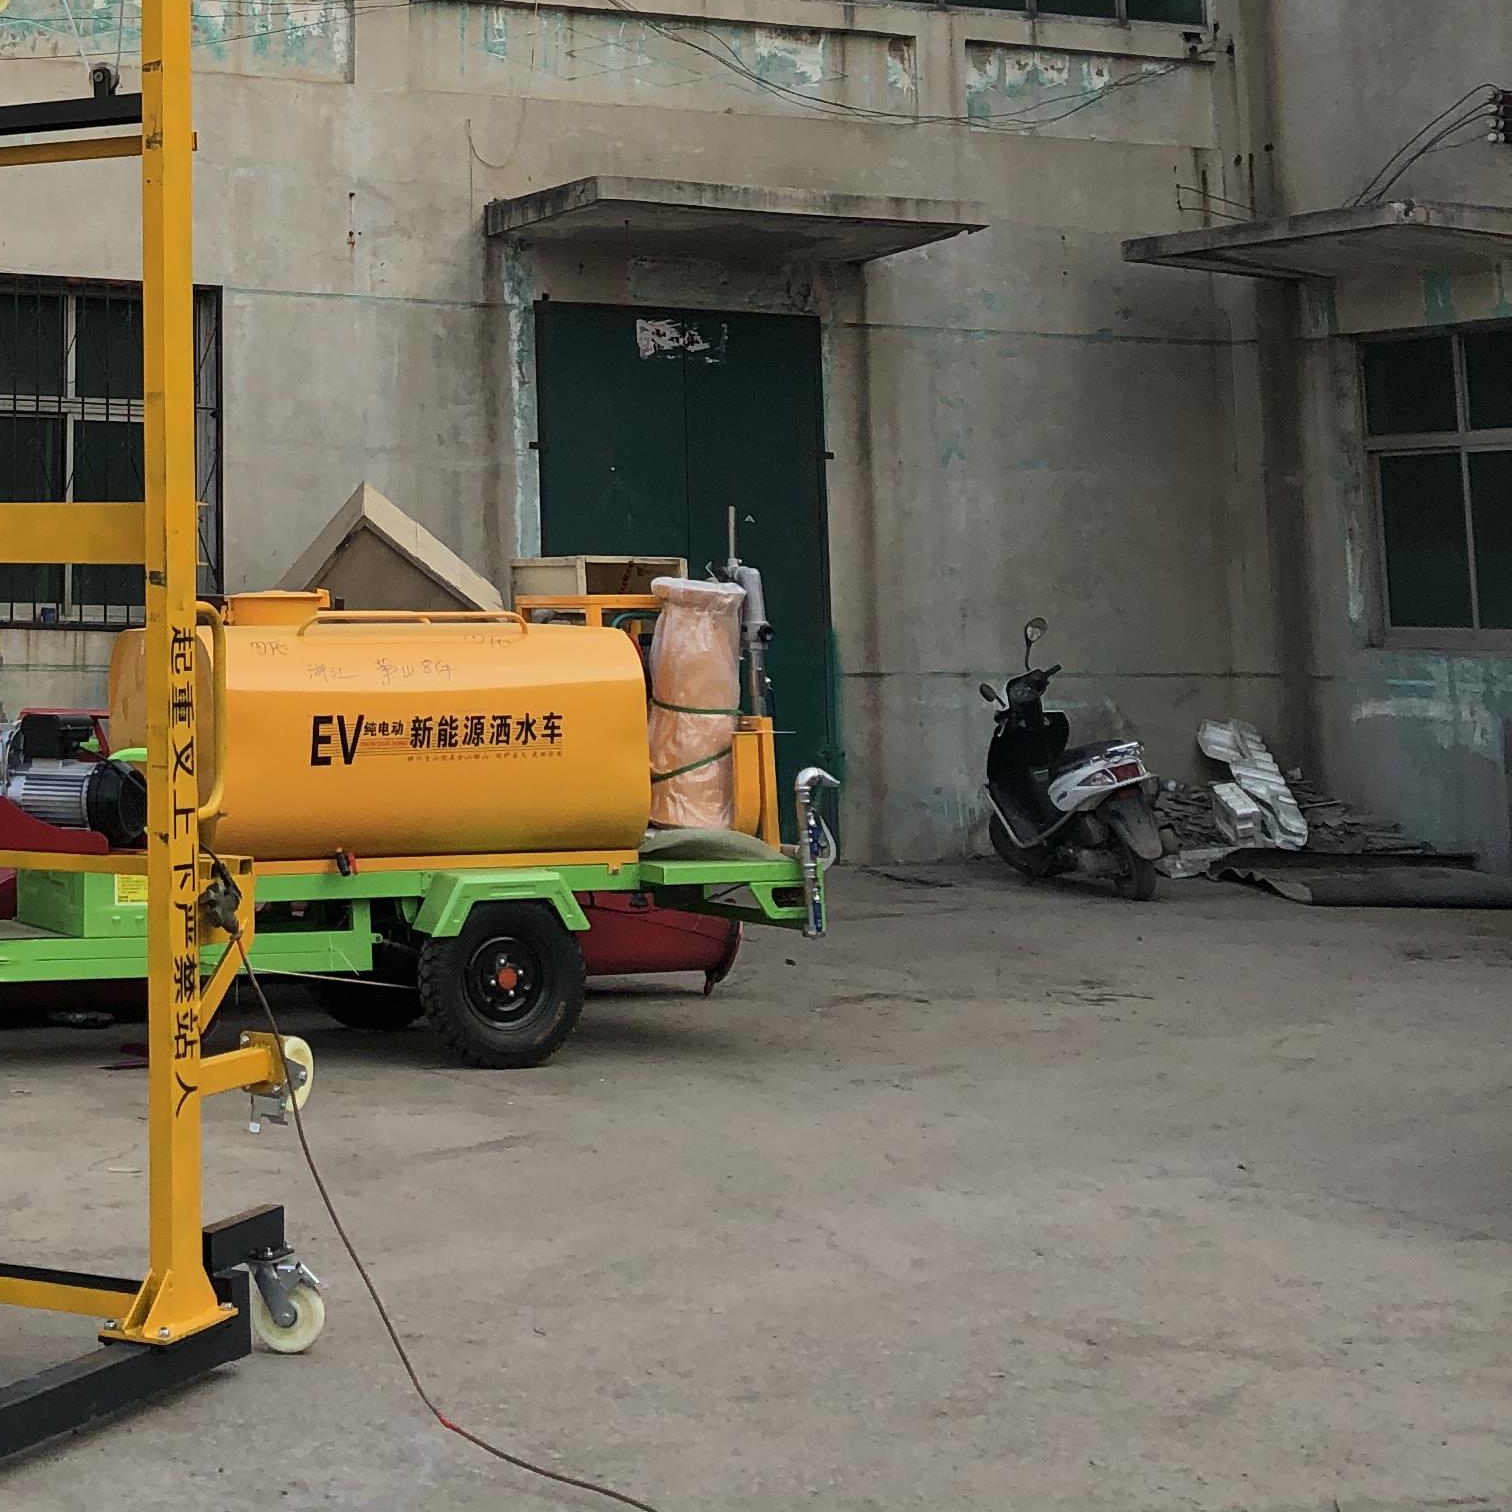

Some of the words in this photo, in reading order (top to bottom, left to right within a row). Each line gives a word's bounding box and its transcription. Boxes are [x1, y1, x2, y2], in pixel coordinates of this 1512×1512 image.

[169, 626, 199, 1119] 起重叉上下严禁站人
[310, 714, 365, 766] EV
[363, 720, 404, 737] 纯电动
[409, 712, 563, 749] 新能源洒水车
